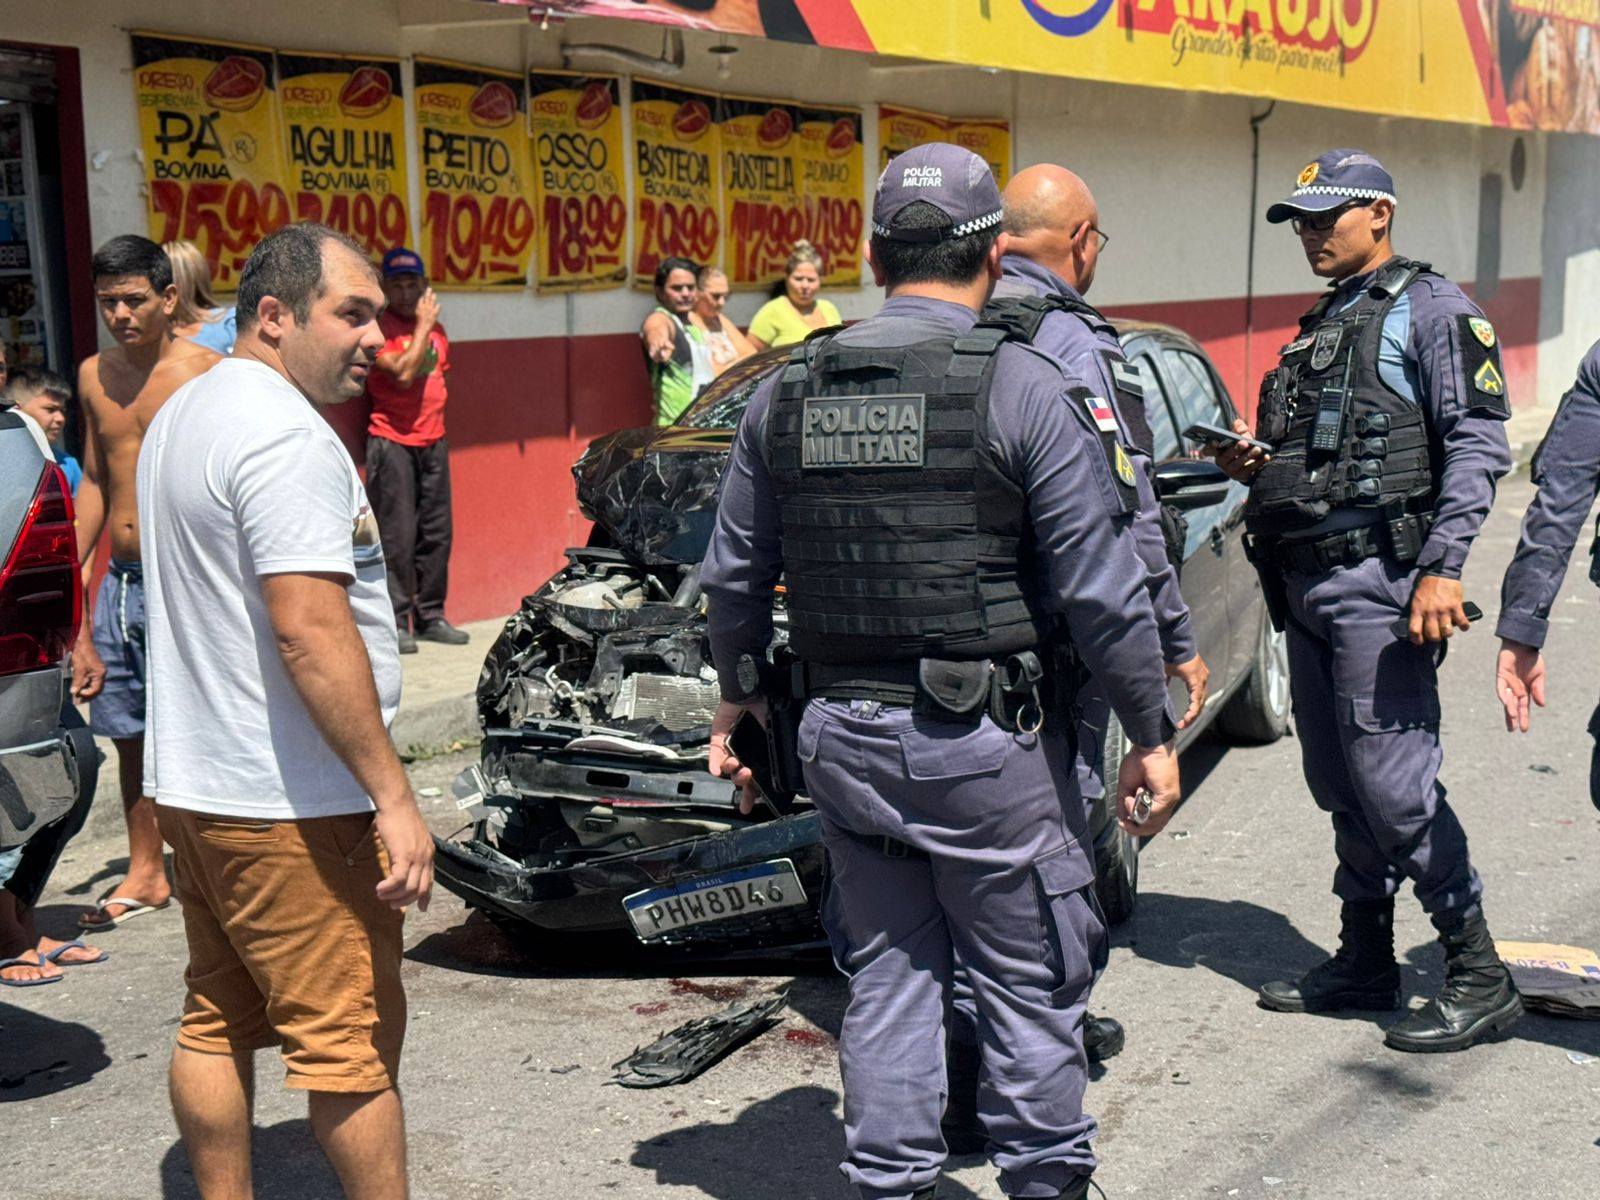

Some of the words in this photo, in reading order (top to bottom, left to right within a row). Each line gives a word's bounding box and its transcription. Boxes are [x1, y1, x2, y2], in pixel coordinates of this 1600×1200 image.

[290, 124, 396, 171] AGULHA
[423, 127, 510, 176] PEITO
[537, 132, 608, 171] OSSO
[154, 159, 232, 180] BOVINA
[301, 170, 370, 192] BOVINA
[426, 168, 498, 194] BOVINO
[543, 170, 596, 192] BUCO
[903, 177, 942, 187] MILITAR
[904, 165, 942, 177] POLÍCIA
[805, 400, 919, 435] POLÍCIA
[804, 434, 919, 464] MILITAR
[695, 877, 723, 889] BRASIL
[645, 878, 784, 929] PHW8D46
